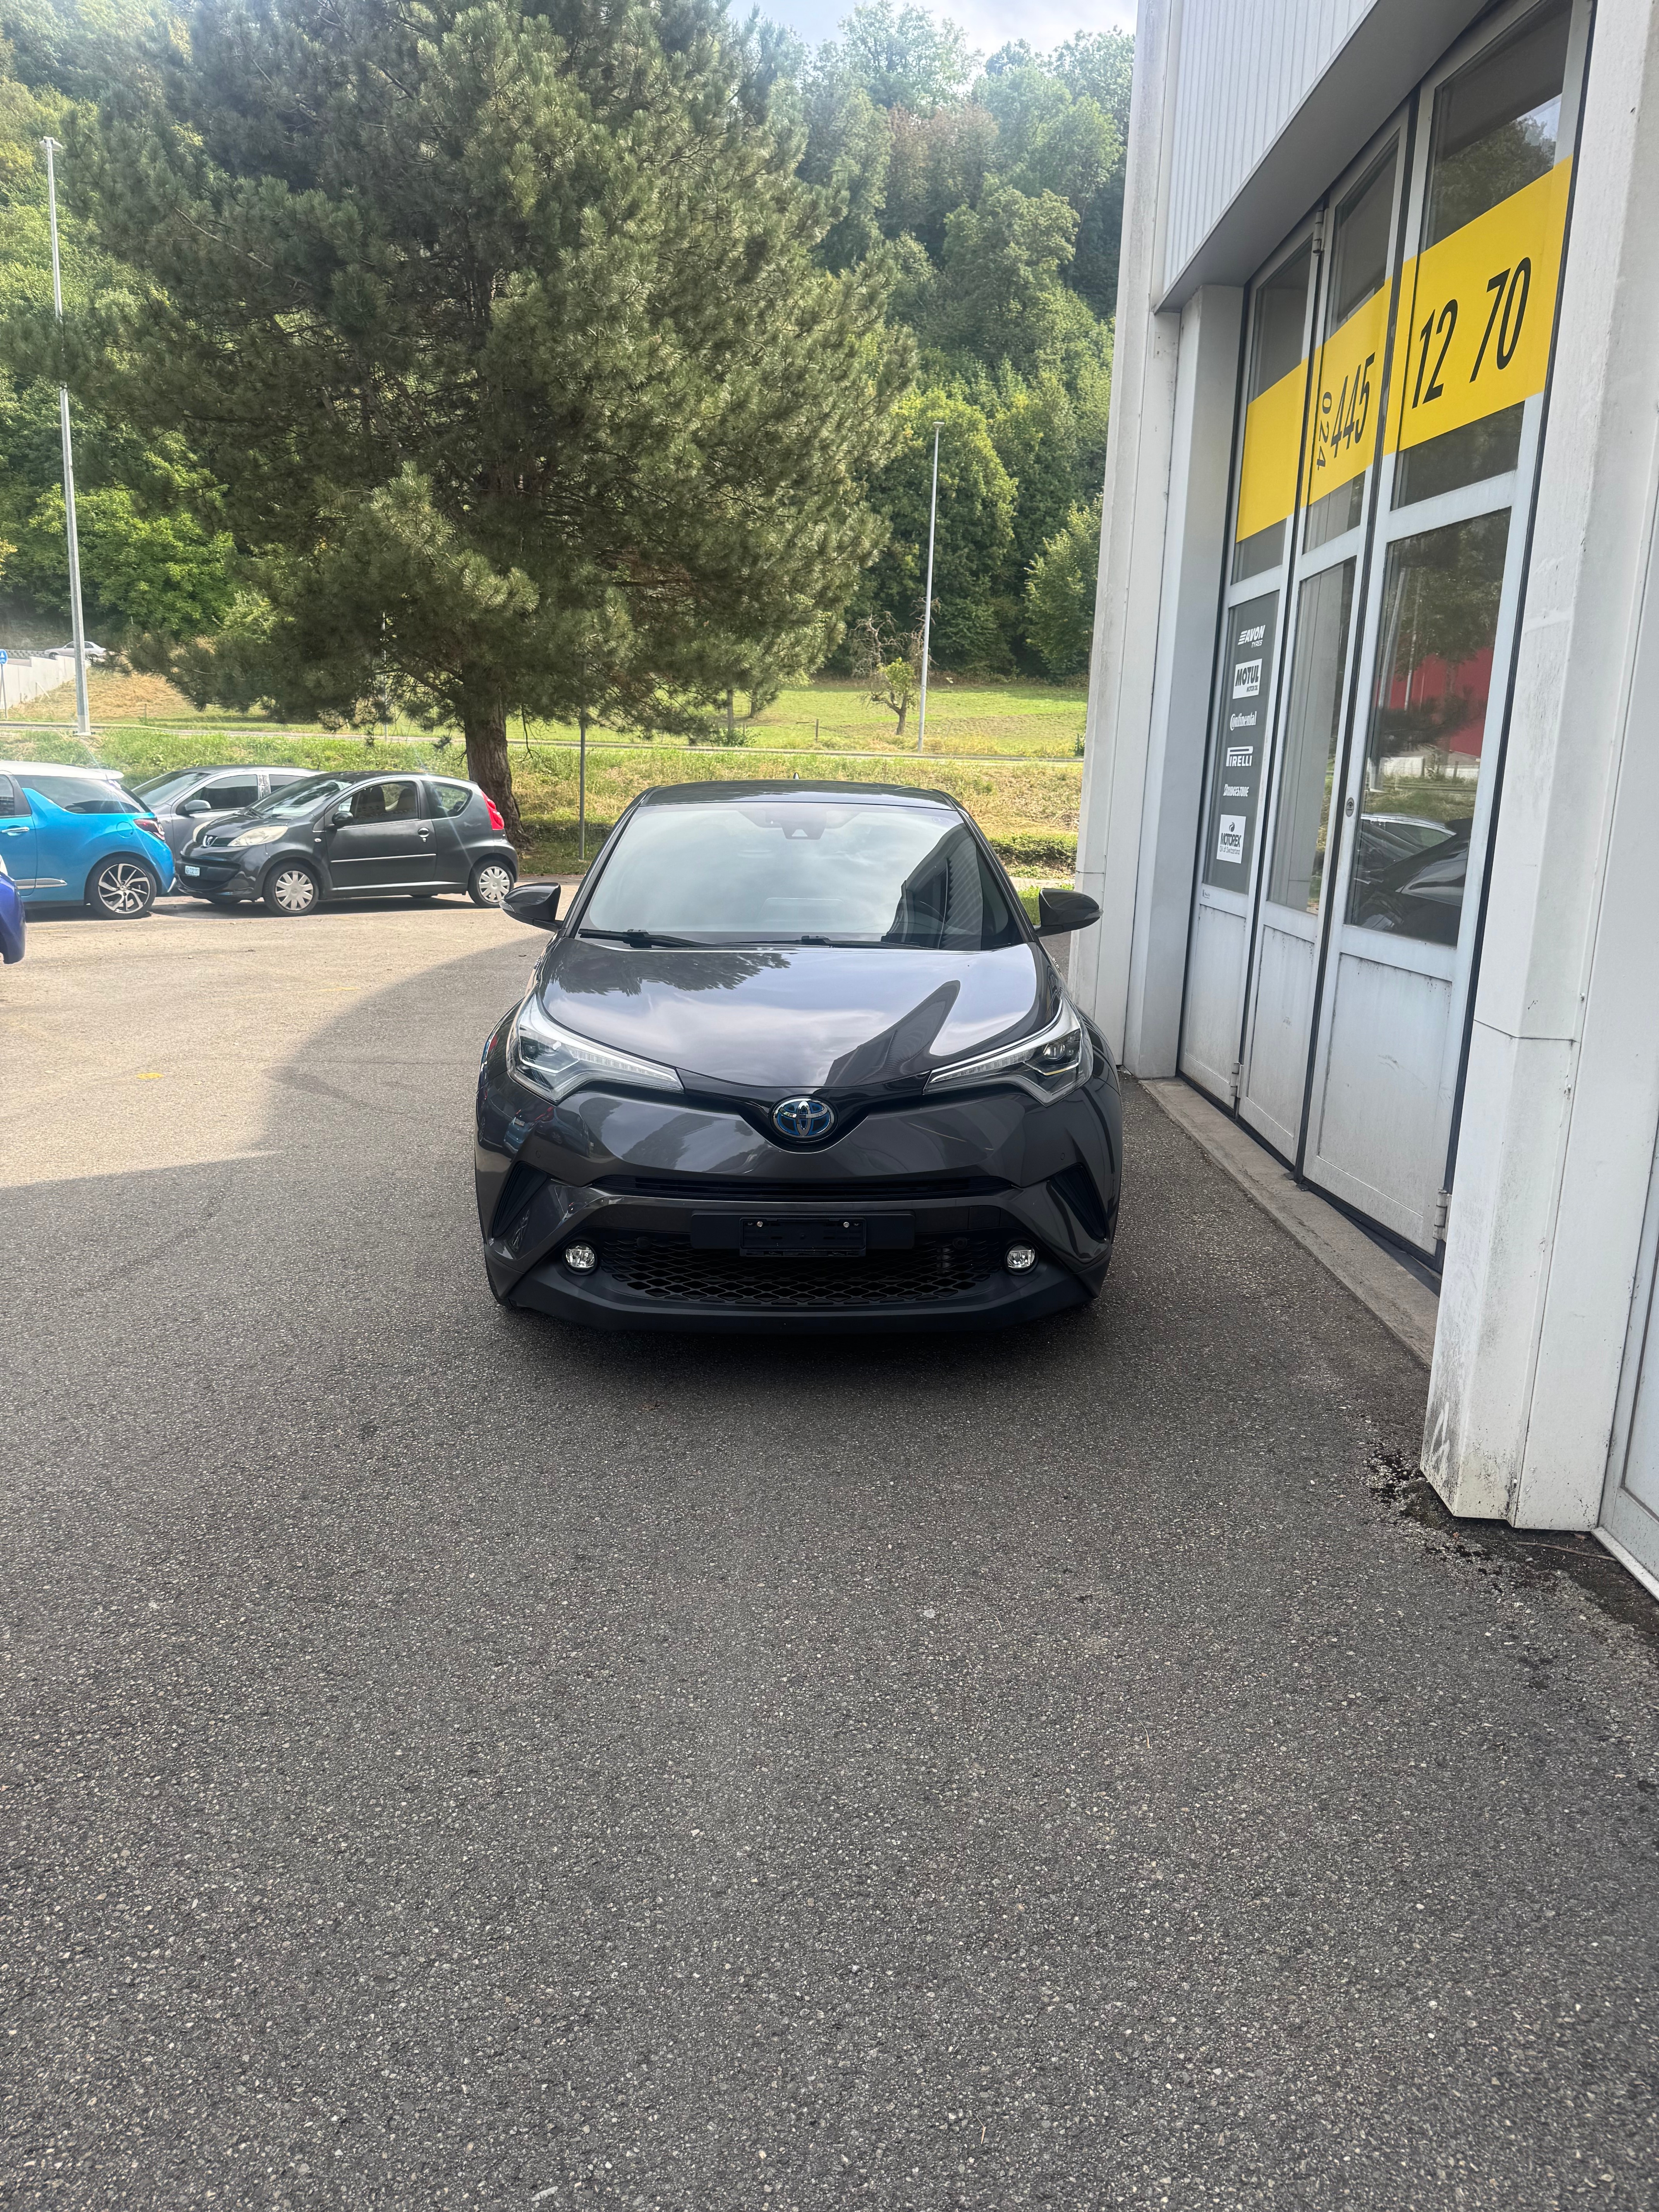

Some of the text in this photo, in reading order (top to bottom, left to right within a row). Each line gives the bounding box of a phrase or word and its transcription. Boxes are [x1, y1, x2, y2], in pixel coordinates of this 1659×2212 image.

[1330, 256, 1531, 459] 445 12 70
[1317, 391, 1332, 471] 024
[1244, 624, 1266, 644] AVON
[1251, 639, 1263, 648] TYRES
[1235, 665, 1259, 687] MOTUL
[1230, 711, 1257, 731] Continental
[1226, 746, 1254, 767] PIRELLI
[1223, 783, 1250, 797] BRIDGESTONE
[1220, 832, 1242, 848] MOTOREX
